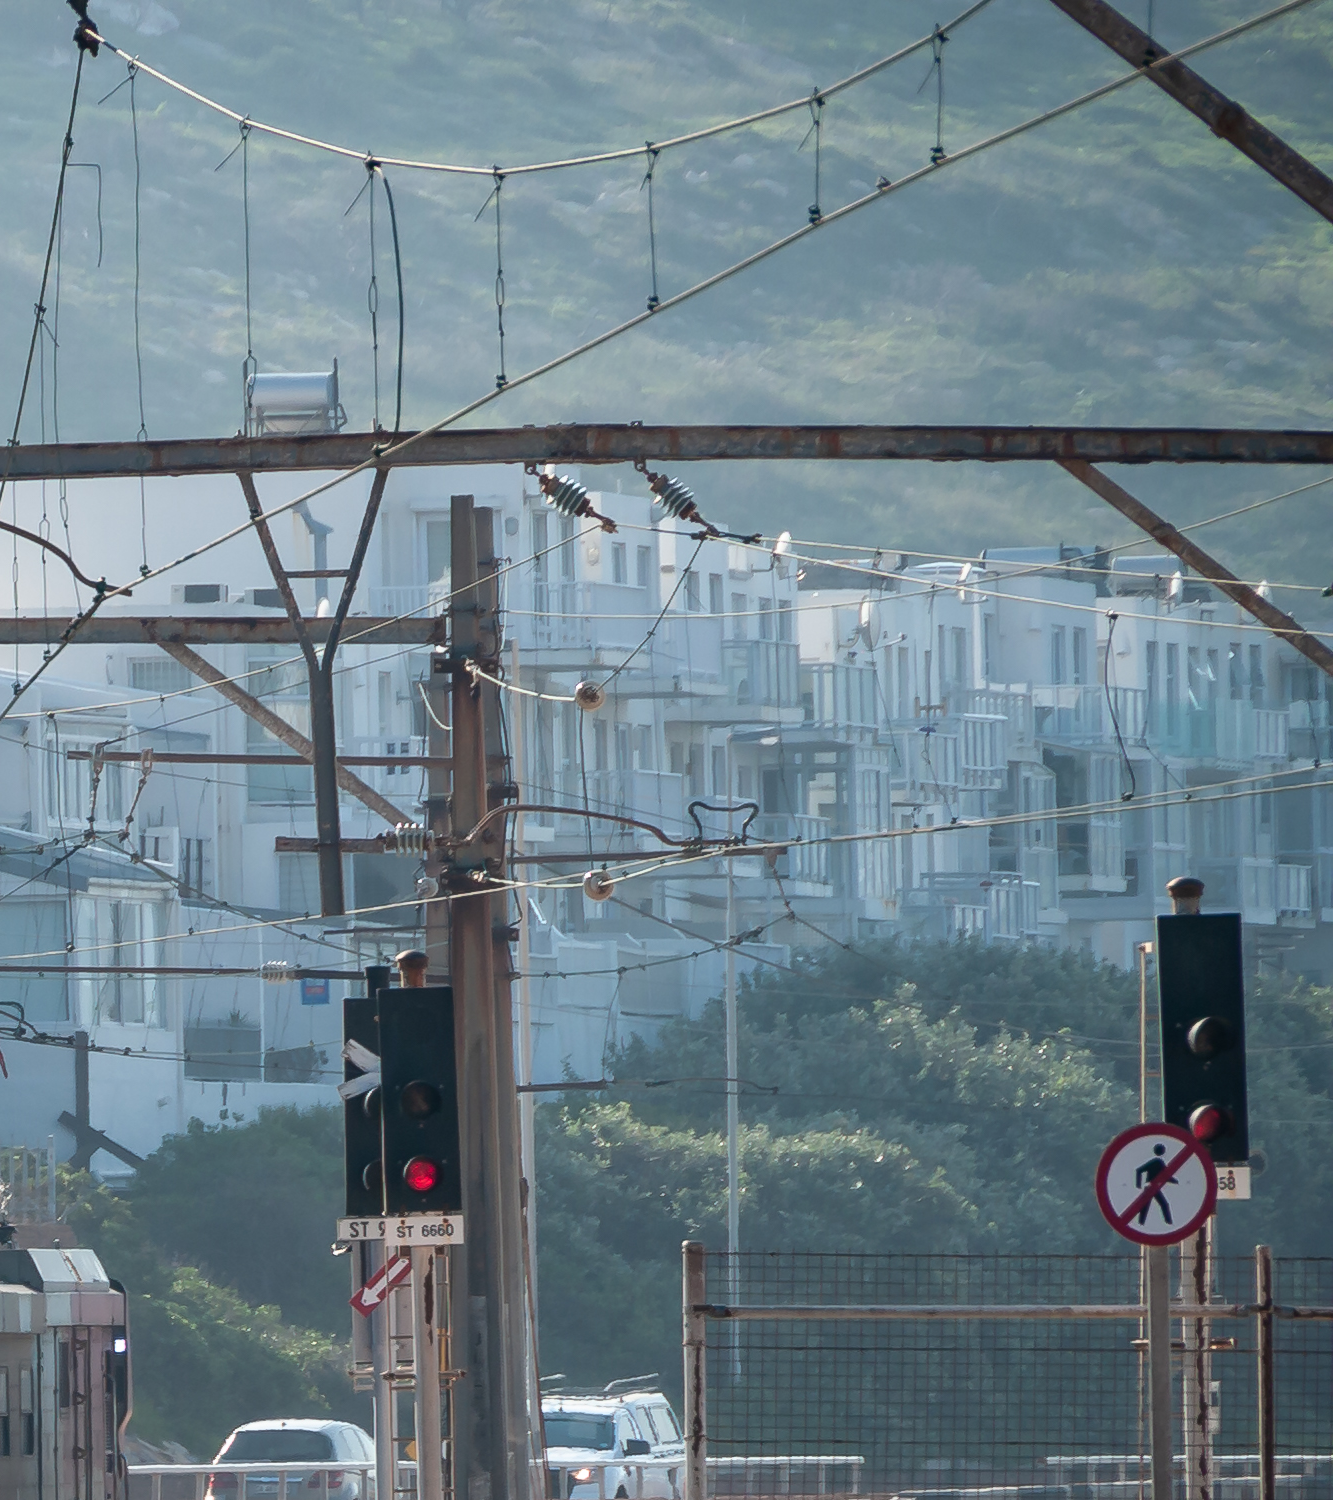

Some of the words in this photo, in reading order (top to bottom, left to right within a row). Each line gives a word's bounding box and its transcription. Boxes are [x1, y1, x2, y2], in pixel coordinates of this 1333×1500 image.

[349, 1221, 369, 1238] ST
[396, 1225, 414, 1238] ST
[421, 1223, 455, 1238] 6660
